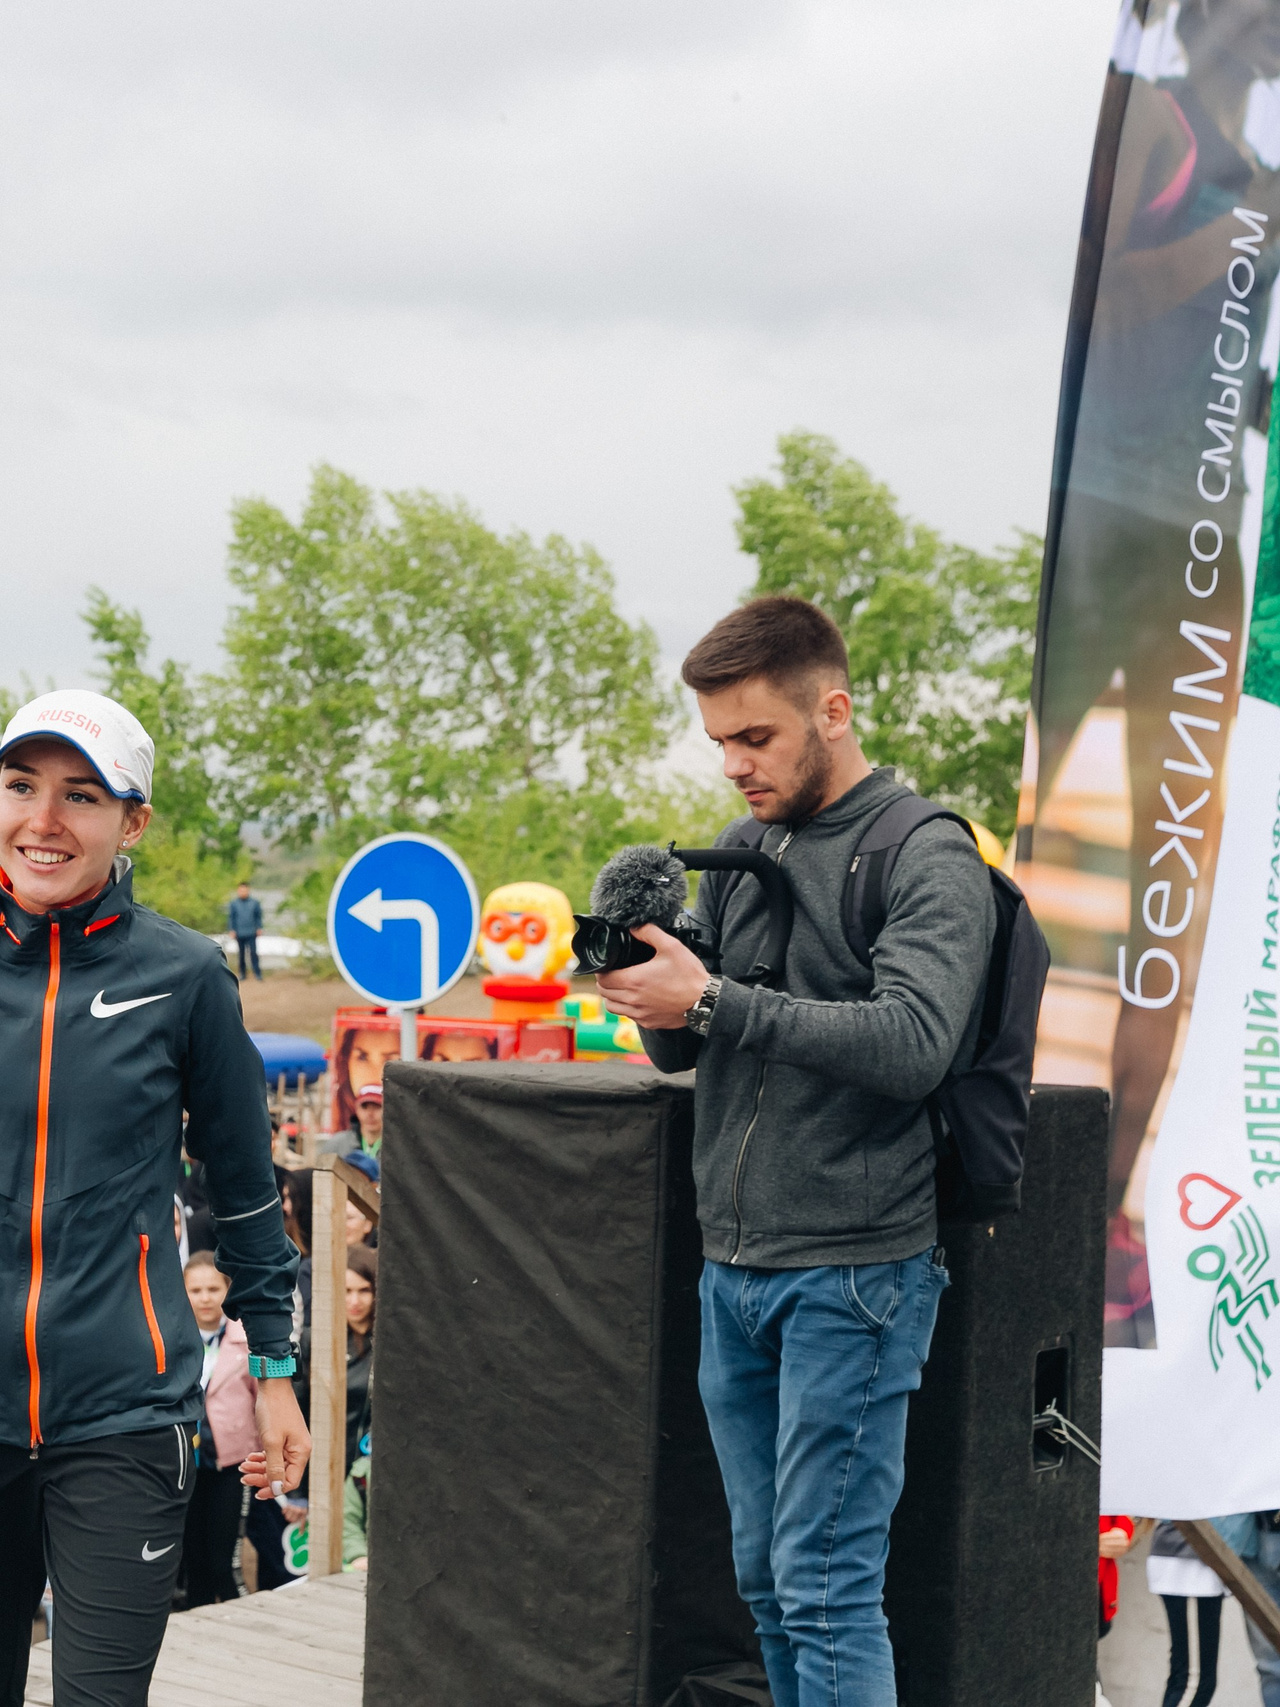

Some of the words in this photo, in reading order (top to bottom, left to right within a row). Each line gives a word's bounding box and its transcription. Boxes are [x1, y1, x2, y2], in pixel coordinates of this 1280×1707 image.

[1197, 207, 1268, 502] смыслом
[1185, 519, 1223, 598] со
[37, 709, 102, 739] RUSSIA
[1118, 619, 1232, 1010] бежим
[1243, 989, 1280, 1189] ЗЕЛЕНЫЙ
